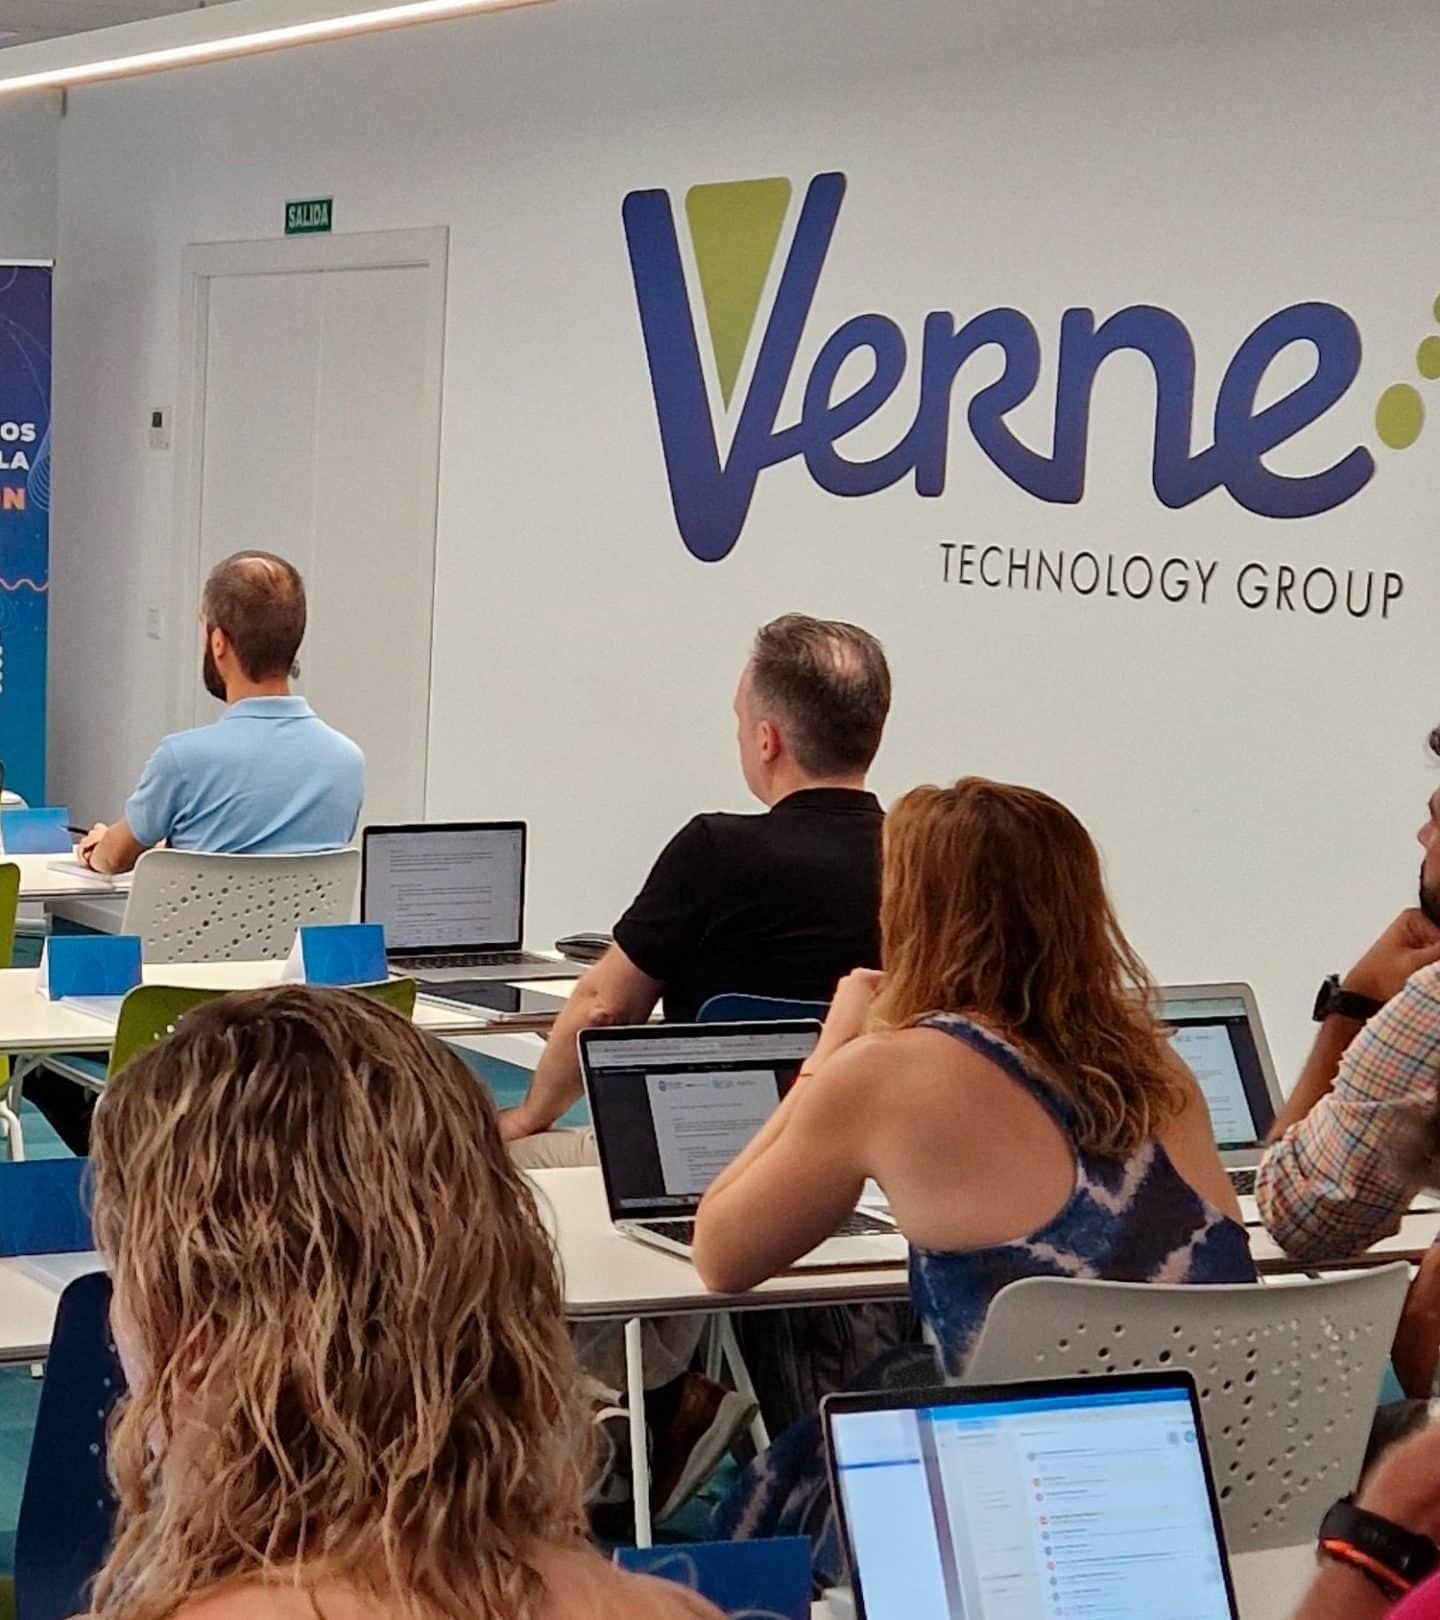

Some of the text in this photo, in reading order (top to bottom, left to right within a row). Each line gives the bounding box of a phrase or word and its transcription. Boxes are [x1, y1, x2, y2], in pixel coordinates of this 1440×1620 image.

[288, 203, 329, 229] SALIDA
[622, 172, 1376, 563] Verne
[940, 543, 1404, 619] TECHNOLOGY GROUP
